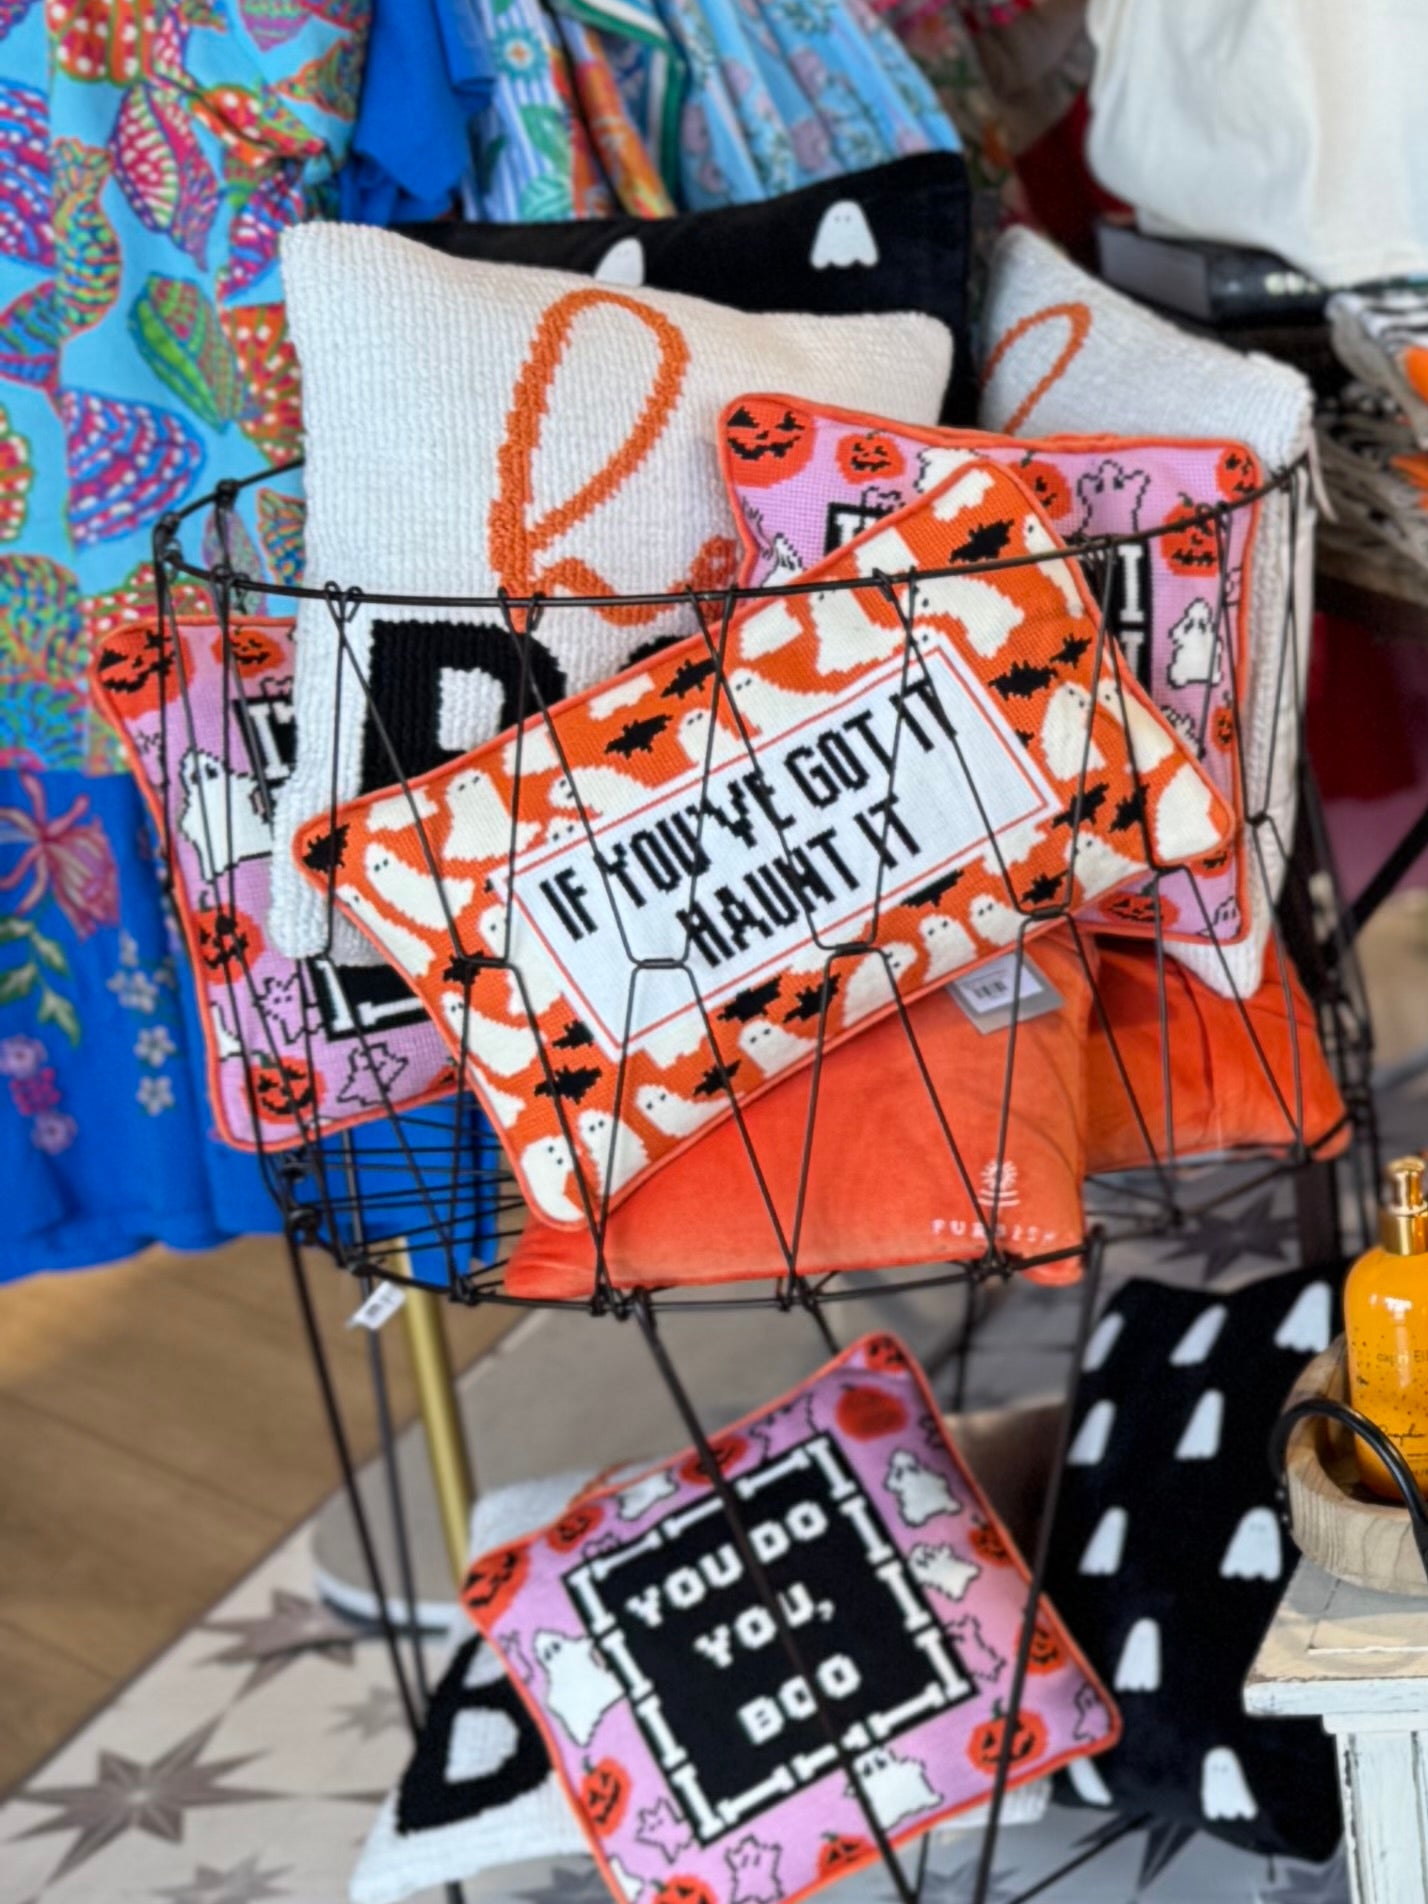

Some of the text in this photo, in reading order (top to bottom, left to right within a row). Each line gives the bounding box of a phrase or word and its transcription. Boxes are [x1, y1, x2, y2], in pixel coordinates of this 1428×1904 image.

[539, 678, 958, 942] IF YOU'VE GOT IT
[675, 795, 922, 969] HAUNT IT
[624, 1500, 829, 1628] YOU DO
[693, 1582, 835, 1669] YOU,
[736, 1652, 862, 1746] BOO
